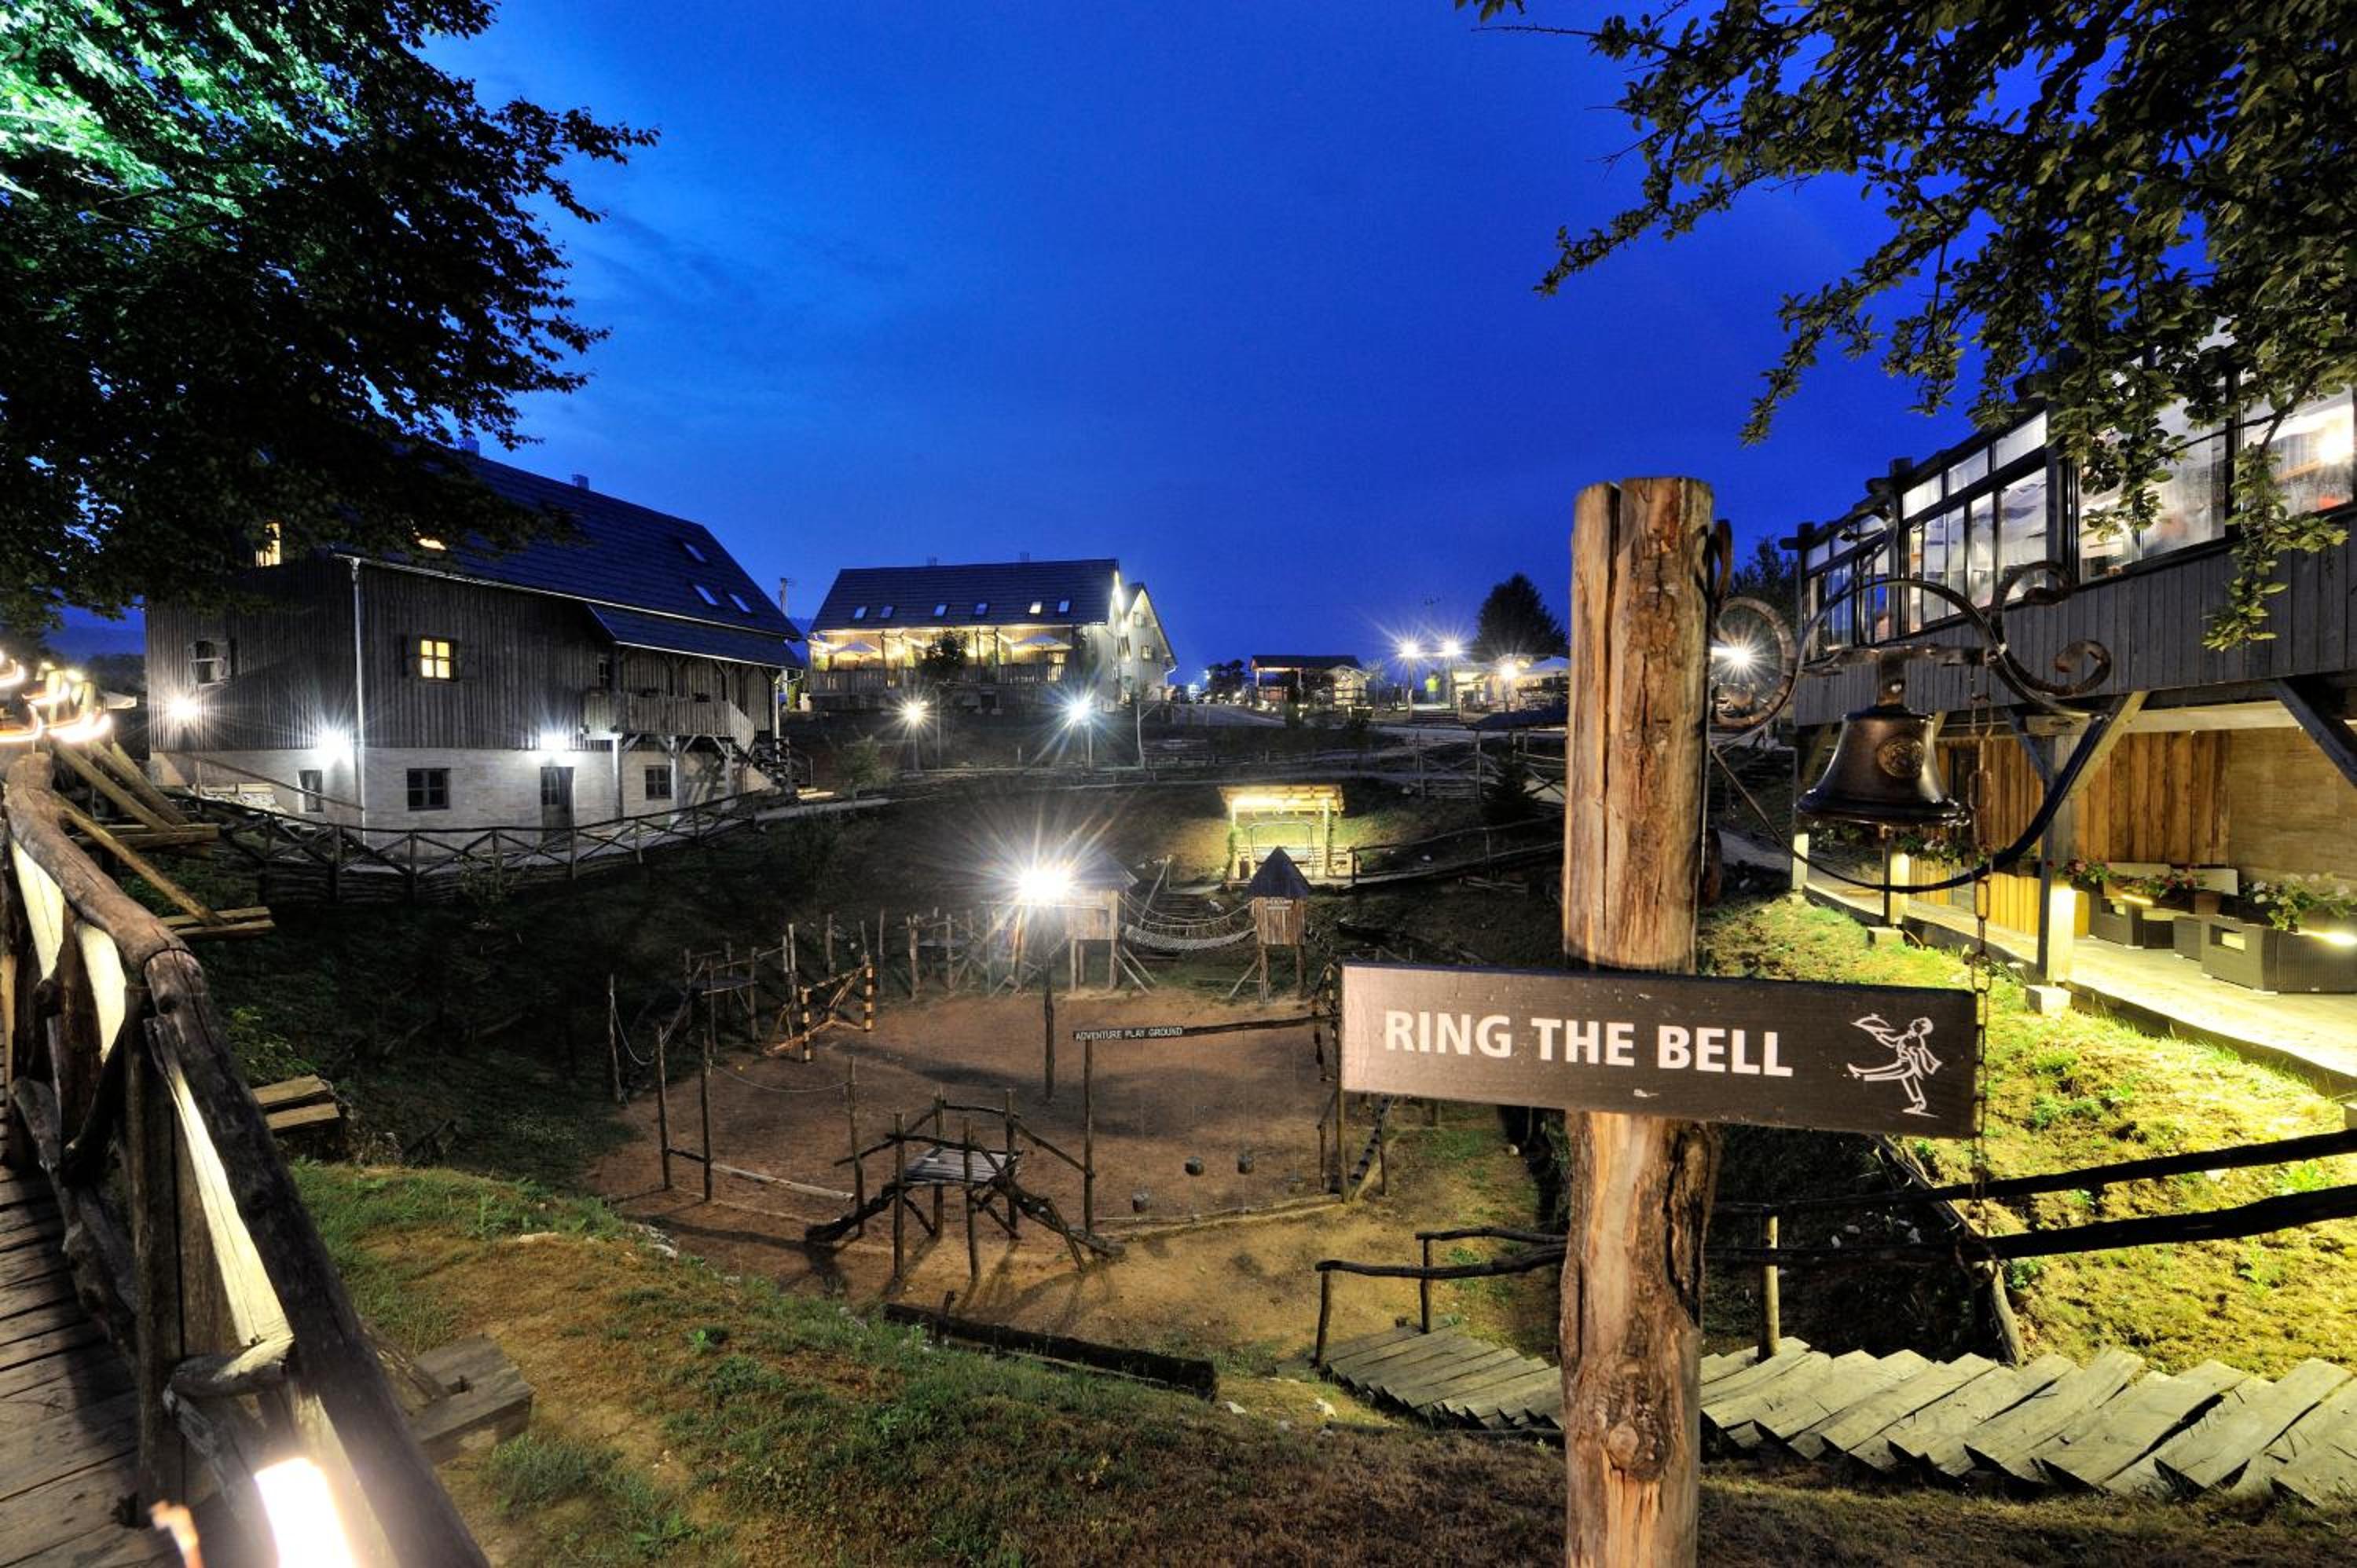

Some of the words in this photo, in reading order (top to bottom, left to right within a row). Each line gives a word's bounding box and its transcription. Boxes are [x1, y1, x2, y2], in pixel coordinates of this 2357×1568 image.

[1076, 1030, 1122, 1041] ADVENTURE
[1124, 1029, 1145, 1038] PLAY
[1148, 1027, 1183, 1036] GROUND
[1384, 1009, 1512, 1058] RING
[1530, 1017, 1635, 1067] THE
[1658, 1025, 1794, 1078] BELL
